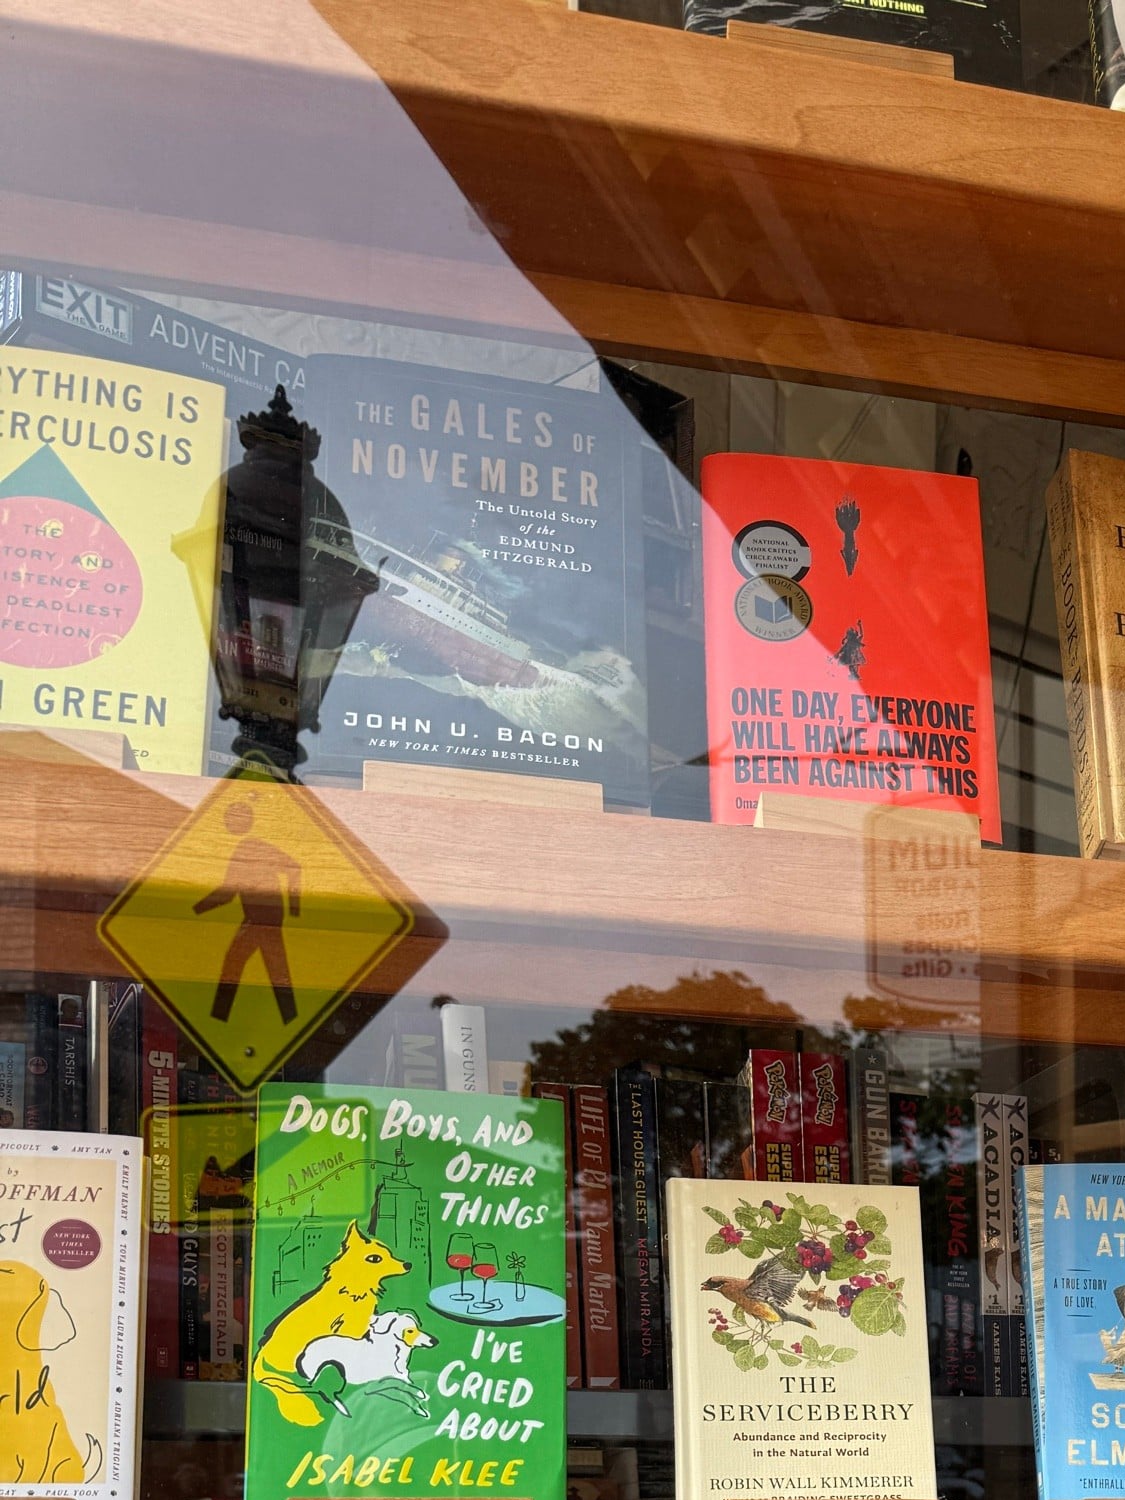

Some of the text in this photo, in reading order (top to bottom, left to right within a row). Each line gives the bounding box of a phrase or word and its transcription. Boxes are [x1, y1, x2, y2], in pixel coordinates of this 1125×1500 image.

[41, 279, 126, 329] EXIT
[150, 314, 266, 377] ADVENT
[167, 392, 199, 423] IS
[356, 394, 596, 454] THE GALES OF
[351, 438, 598, 507] NOVEMBER
[475, 500, 598, 527] The Untold Story
[519, 524, 556, 535] of the
[481, 548, 593, 573] FITZGERALD
[500, 535, 576, 555] EDMUND
[34, 683, 166, 727] GREEN
[731, 687, 976, 733] ONE DAY, EVERYONE
[343, 712, 603, 752] JOHN U. BACON
[732, 720, 970, 765] WILL HAVE ALWAYS
[733, 755, 978, 799] BEEN AGAINST THIS
[147, 1049, 171, 1236] 5-MINUTE STORIES
[472, 1122, 534, 1146] AND
[445, 1151, 536, 1188] OTHER
[440, 1193, 549, 1229] THINGS
[1054, 1195, 1070, 1220] A
[470, 1329, 523, 1363] I'VE
[437, 1360, 534, 1409] CRIED
[780, 1376, 836, 1393] THE
[435, 1408, 544, 1443] ABOUT
[703, 1403, 914, 1422] SERVICEBERRY
[733, 1432, 887, 1443] Abundance and Reciprocity
[753, 1447, 869, 1458] in the Natural World
[286, 1451, 525, 1488] ISABEL KLEE
[710, 1476, 914, 1490] ROBIN WALL KIMMERER
